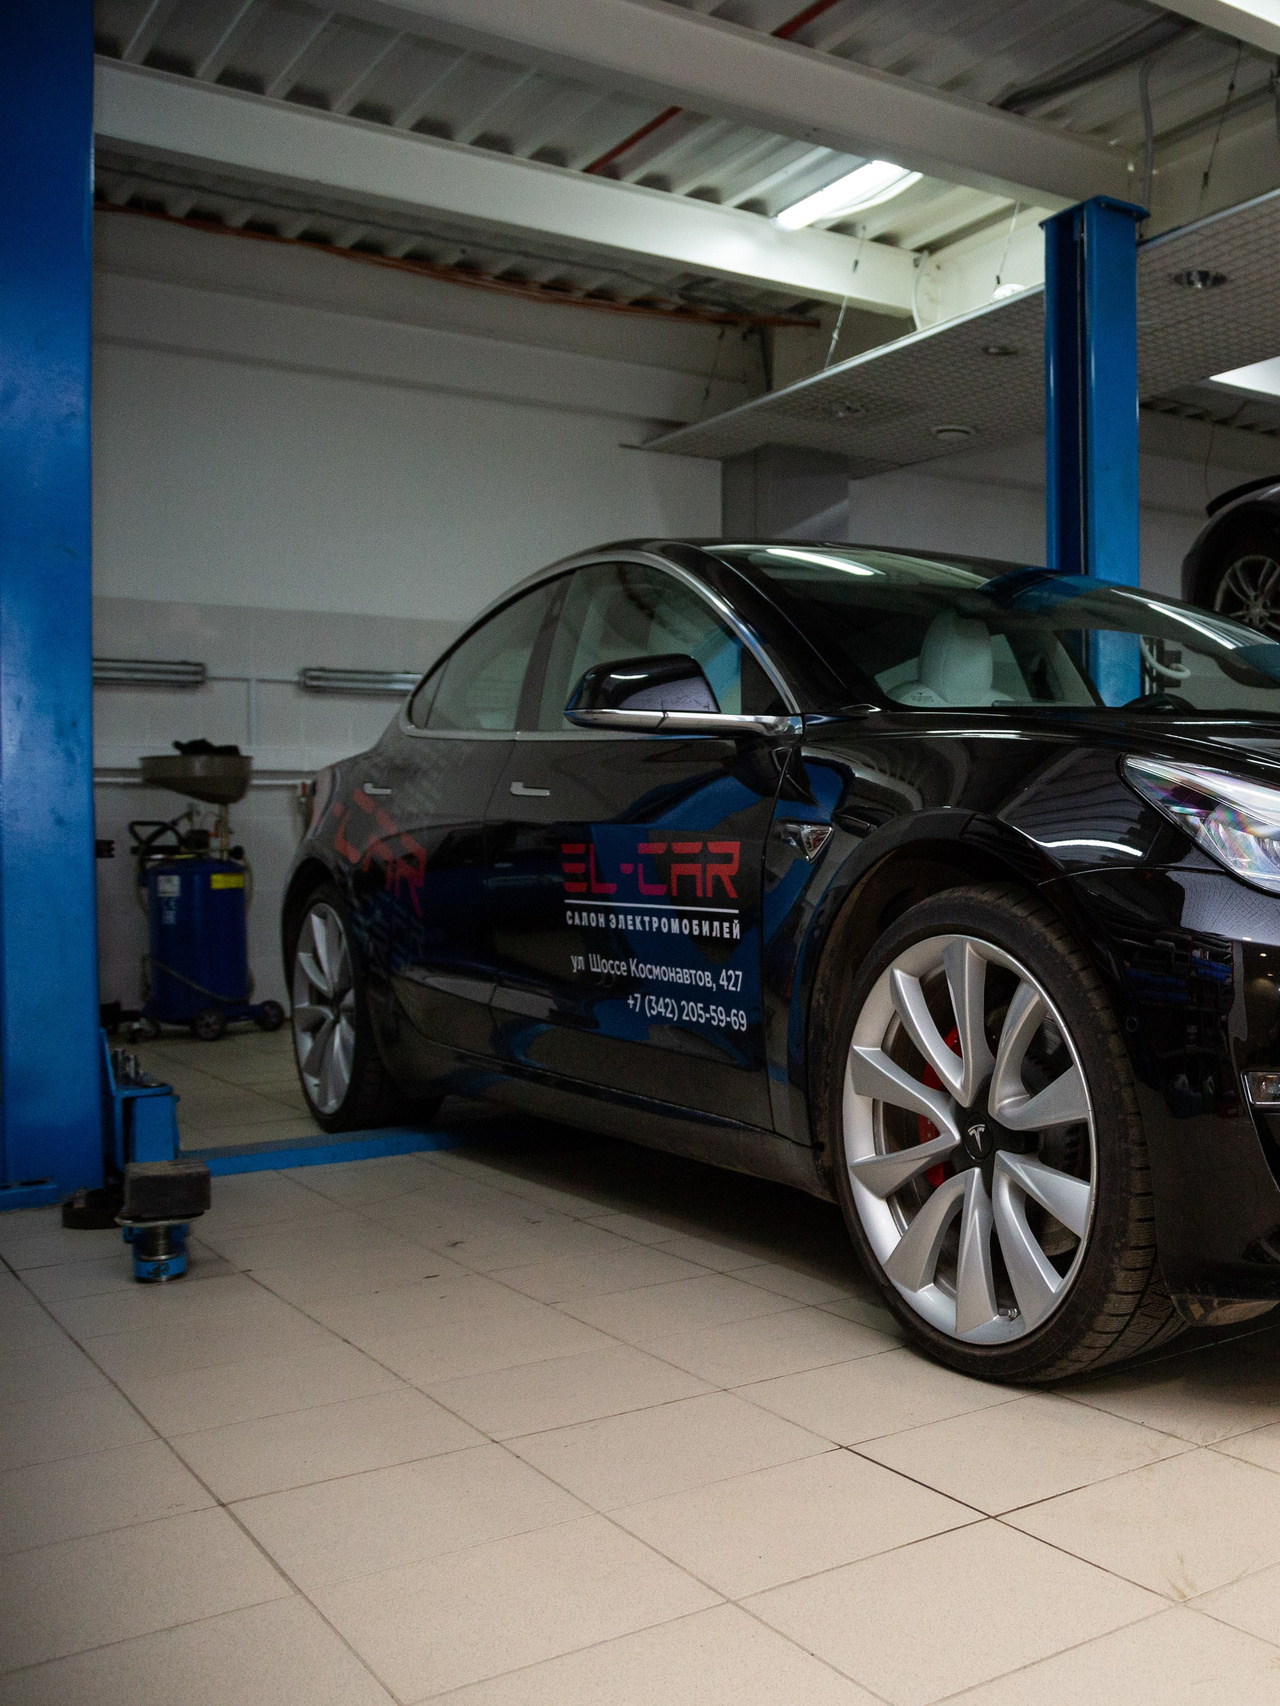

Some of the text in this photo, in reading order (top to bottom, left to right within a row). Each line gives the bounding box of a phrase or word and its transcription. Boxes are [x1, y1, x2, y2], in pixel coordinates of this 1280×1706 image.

[561, 841, 741, 898] EL-CAR
[566, 910, 741, 940] САЛОН ЭЛЕКТРОМОБИЛЕЙ
[571, 953, 743, 992] ул Шоссе Космонавтов, 427
[627, 994, 747, 1032] +7 (342) 205-59-69
